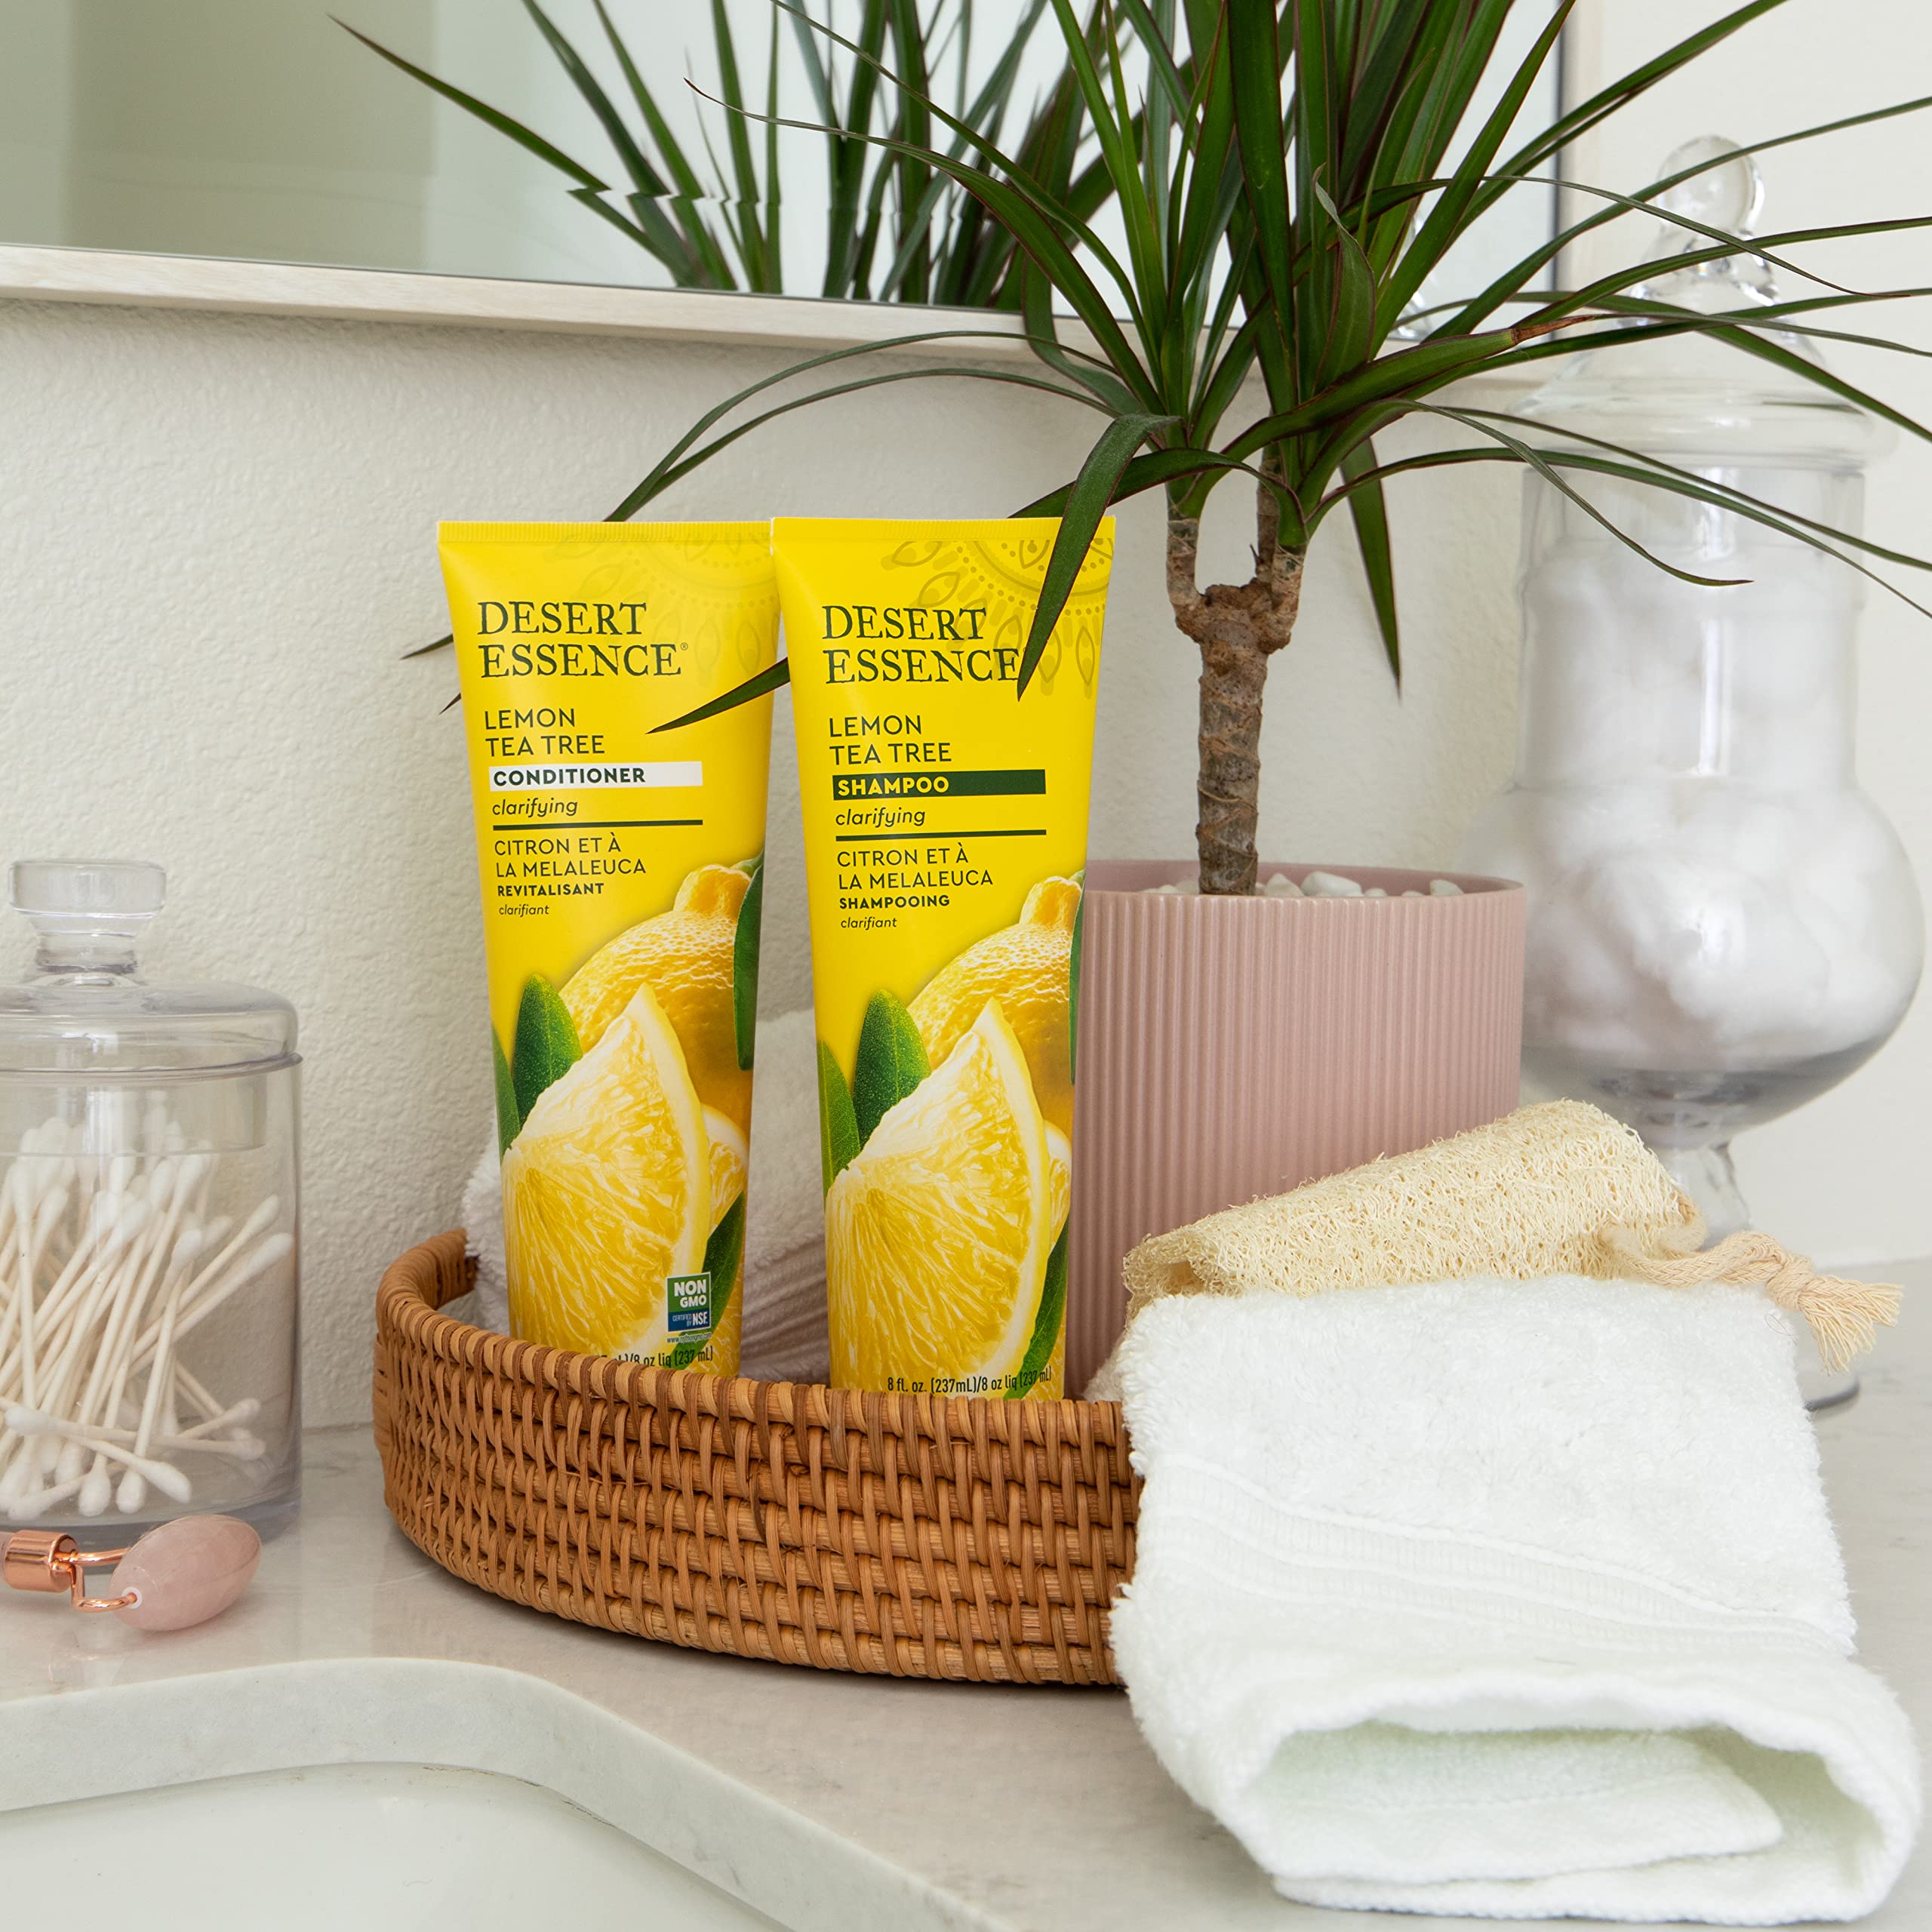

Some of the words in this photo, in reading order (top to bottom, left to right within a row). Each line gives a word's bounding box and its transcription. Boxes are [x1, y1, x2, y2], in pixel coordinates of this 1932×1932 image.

[478, 601, 646, 635] DESERT
[822, 606, 986, 640] DESERT
[485, 709, 574, 730] LEMON
[829, 715, 921, 737] LEMON
[485, 737, 534, 756] TEA
[541, 735, 605, 754] TREE
[829, 744, 881, 764] TEA
[888, 743, 951, 762] TREE
[494, 768, 645, 786] CONDITIONER
[838, 776, 949, 795] SHAMPOO
[493, 798, 577, 817] clarifying
[836, 808, 924, 828] clarifying
[495, 839, 569, 855] CITRON
[580, 838, 601, 852] ET
[609, 832, 620, 852] À
[838, 850, 917, 866] CITRON
[928, 848, 949, 863] ET
[956, 842, 968, 863] À
[497, 863, 516, 877] LA
[524, 859, 645, 877] MELALEUCA
[839, 875, 862, 889] LA
[870, 870, 992, 888] MELALEUCA
[498, 883, 604, 896] REVITALISANT
[500, 904, 549, 917] clarifiant
[840, 895, 949, 909] SHAMPOOING
[841, 917, 897, 930] clarifiant
[674, 1279, 706, 1297] NON
[680, 1295, 707, 1308] GMO
[672, 1313, 692, 1322] CERTIFIED
[658, 1352, 672, 1367] liq
[675, 1350, 695, 1366] (237
[697, 1345, 713, 1361] mL)
[888, 1377, 894, 1391] 8
[897, 1377, 909, 1392] fl.
[912, 1381, 927, 1392] oz.
[991, 1380, 1002, 1390] oz
[1005, 1374, 1017, 1390] liq
